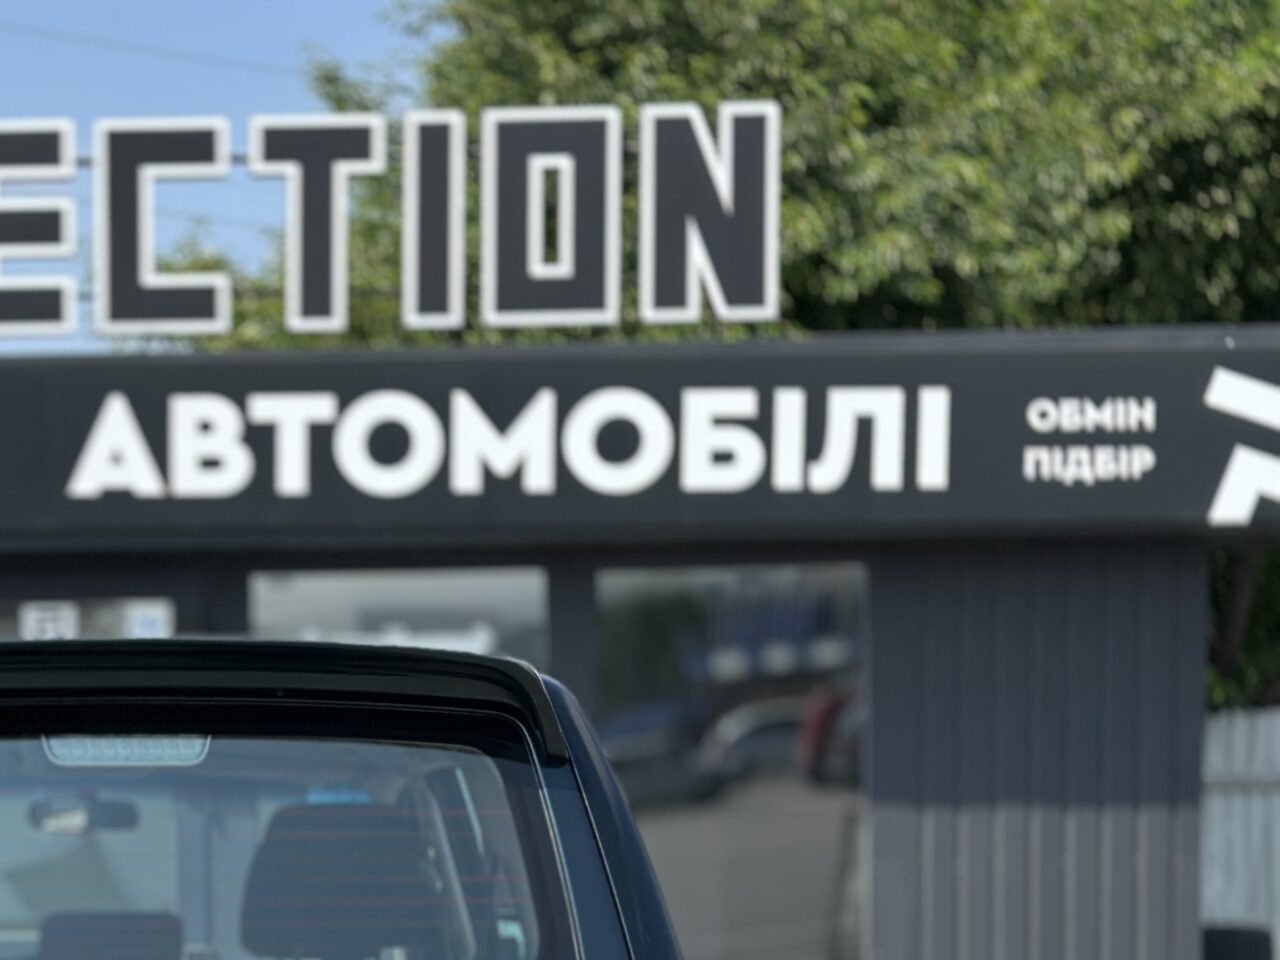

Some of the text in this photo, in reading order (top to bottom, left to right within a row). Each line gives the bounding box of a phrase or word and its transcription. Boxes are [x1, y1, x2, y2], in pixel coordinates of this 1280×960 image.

[1025, 397, 1157, 433] ОБМІН
[64, 384, 952, 499] АВТОМОБІЛІ
[1022, 445, 1157, 486] ПІДБІР
